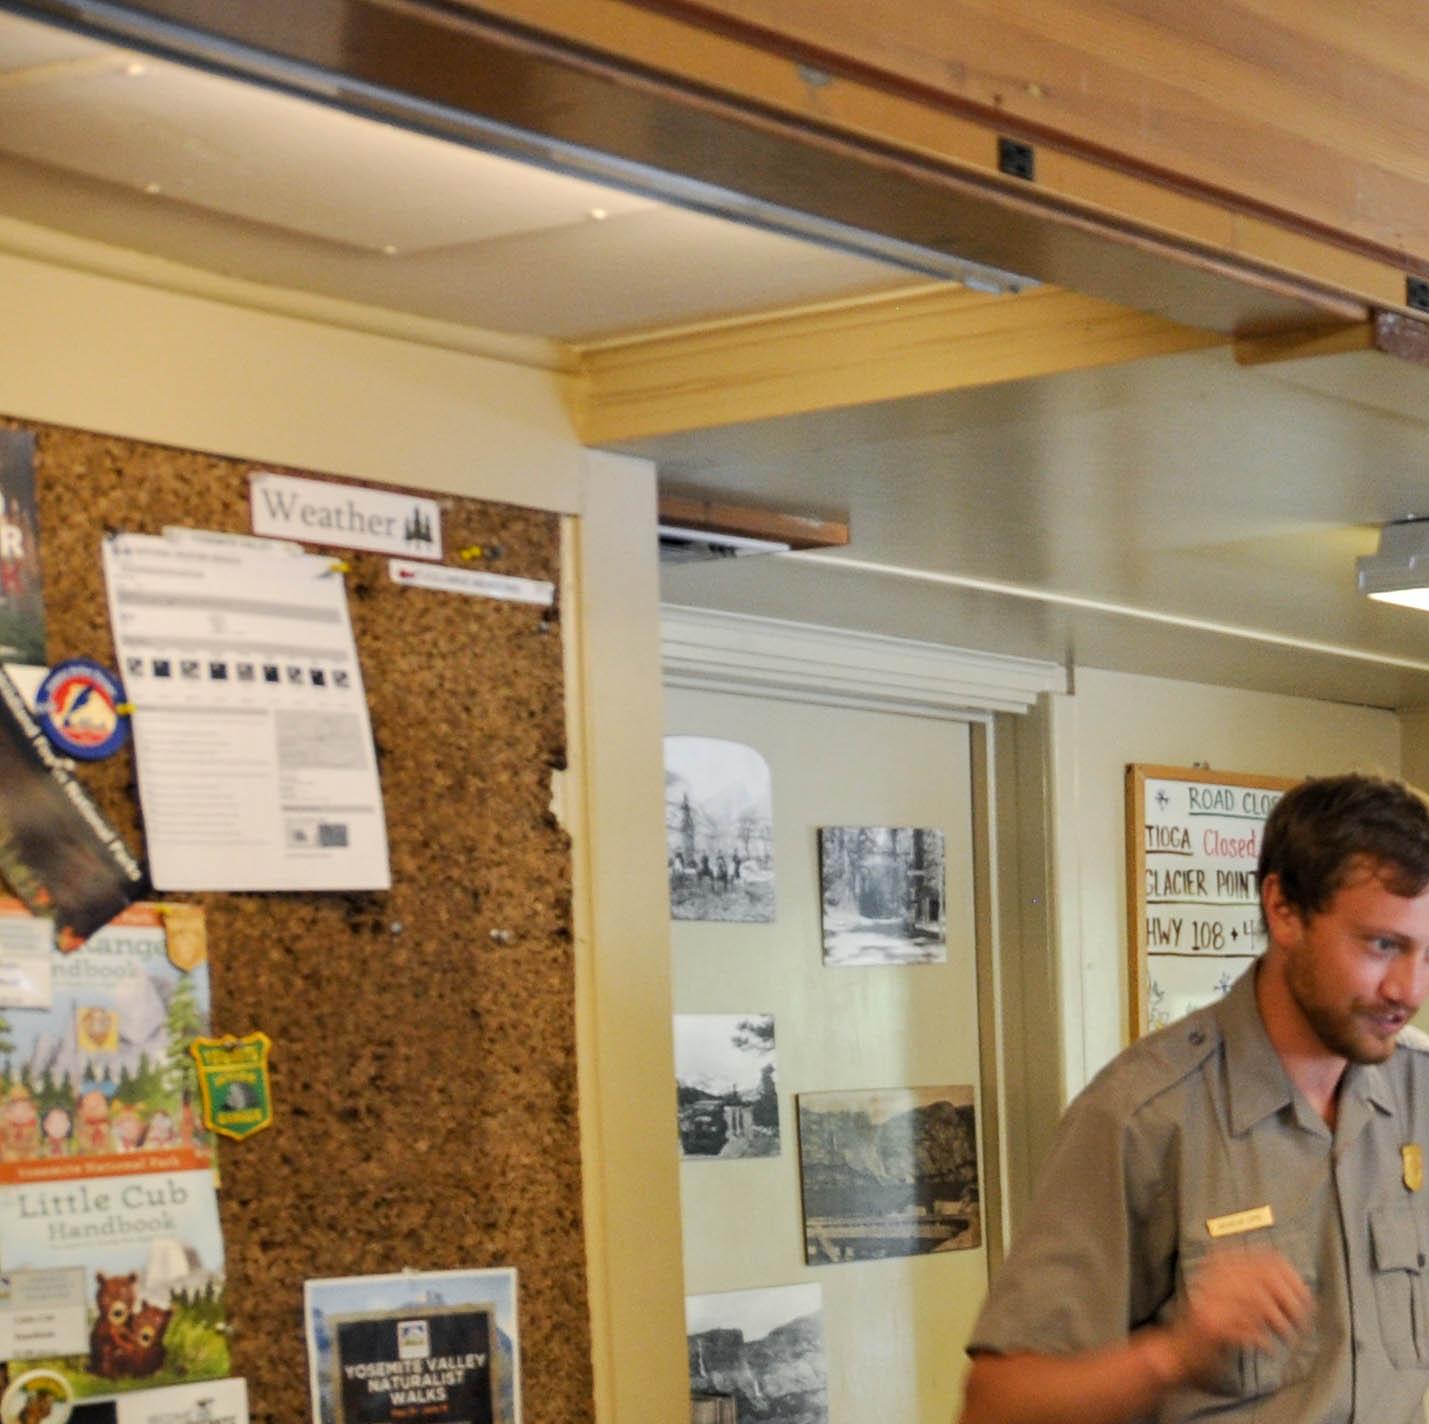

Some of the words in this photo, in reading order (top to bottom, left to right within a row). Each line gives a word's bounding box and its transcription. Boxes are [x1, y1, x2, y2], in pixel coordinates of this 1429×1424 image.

[261, 488, 397, 538] Weather
[1188, 787, 1234, 811] ROAD
[1242, 792, 1279, 816] CLOS
[1145, 825, 1191, 850] TIOGA
[1203, 828, 1258, 858] Closed
[1145, 869, 1208, 897] GLACIER
[1146, 918, 1183, 947] HWY
[1192, 920, 1225, 951] 108
[19, 1186, 110, 1219] Little
[121, 1179, 189, 1209] Cub
[48, 1211, 176, 1242] Handbook
[345, 1359, 423, 1380] YOSEMITE
[426, 1353, 488, 1372] VALLEY
[367, 1371, 466, 1392] NATURALIST
[390, 1386, 447, 1406] WALKS
